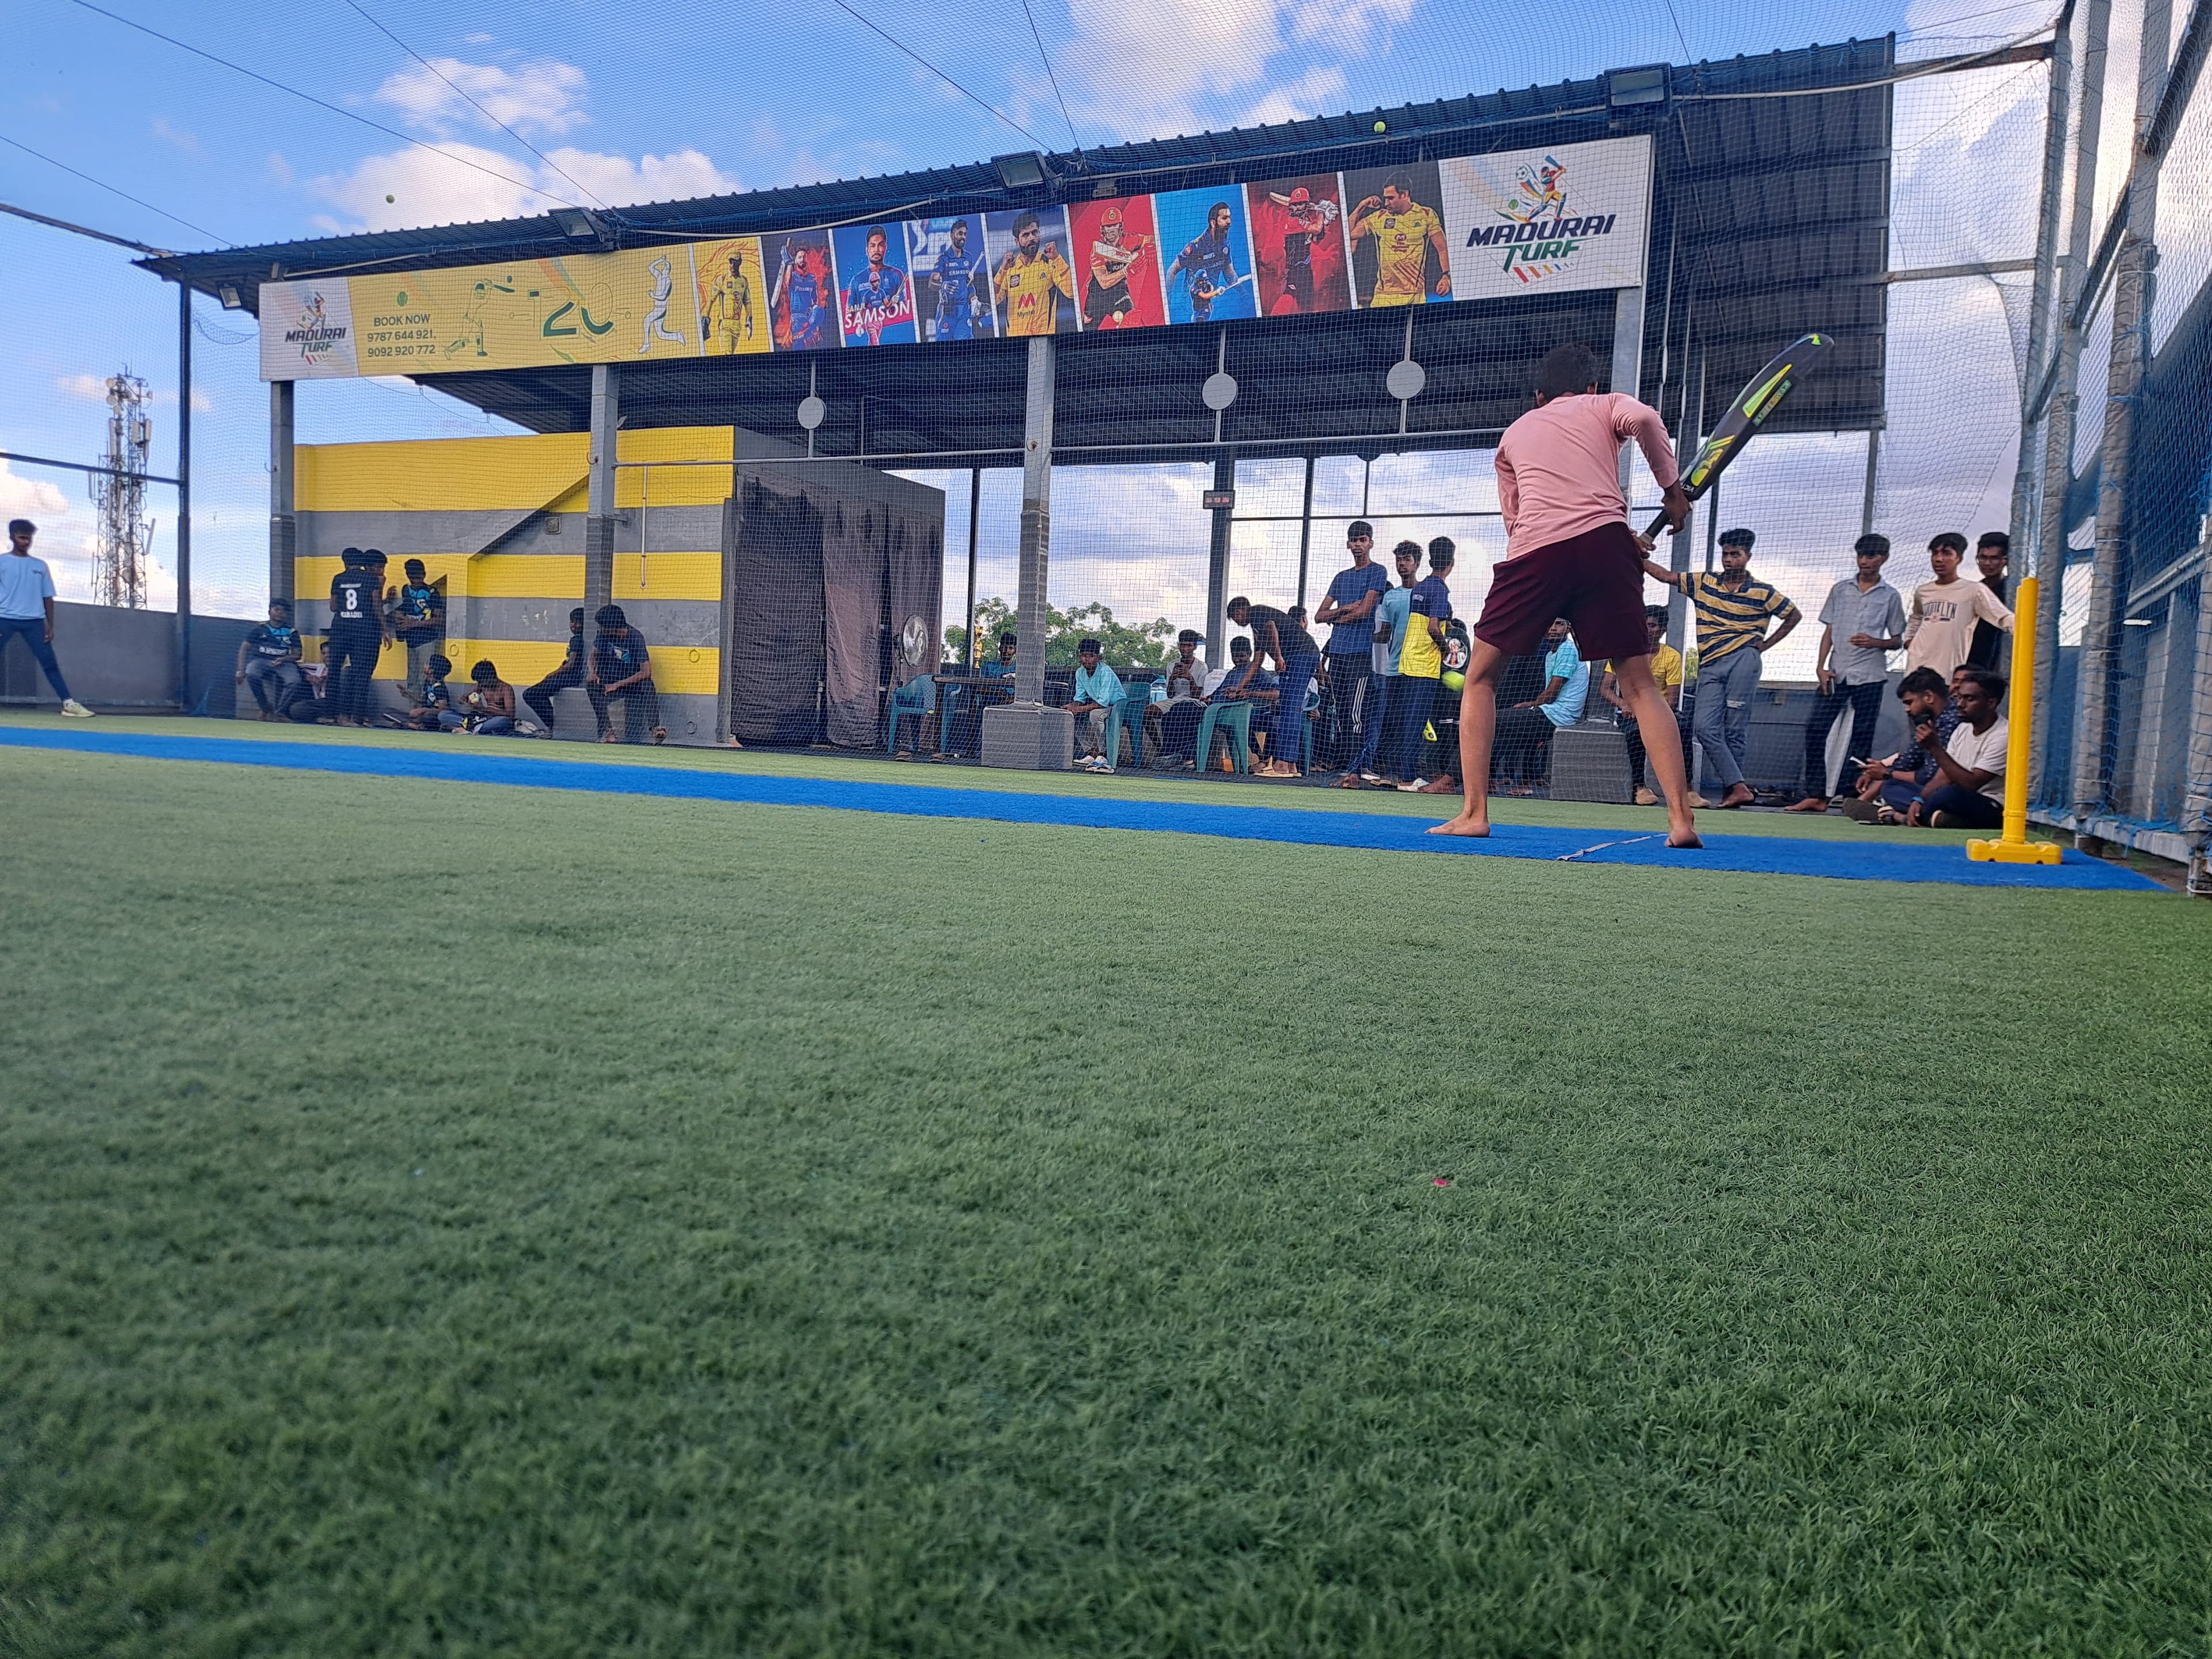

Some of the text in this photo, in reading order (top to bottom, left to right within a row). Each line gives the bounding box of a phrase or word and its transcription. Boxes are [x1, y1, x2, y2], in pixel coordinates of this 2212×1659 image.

[1466, 214, 1617, 247] MADURAI
[1483, 237, 1599, 273] TURF
[374, 313, 430, 327] BOOK NOW
[845, 299, 911, 329] SAMSON
[285, 327, 347, 343] MADURAI
[368, 332, 393, 342] 9787
[395, 330, 414, 340] 644
[292, 340, 339, 358] TURF
[368, 344, 435, 357] 9092 920 772
[346, 589, 358, 611] 8
